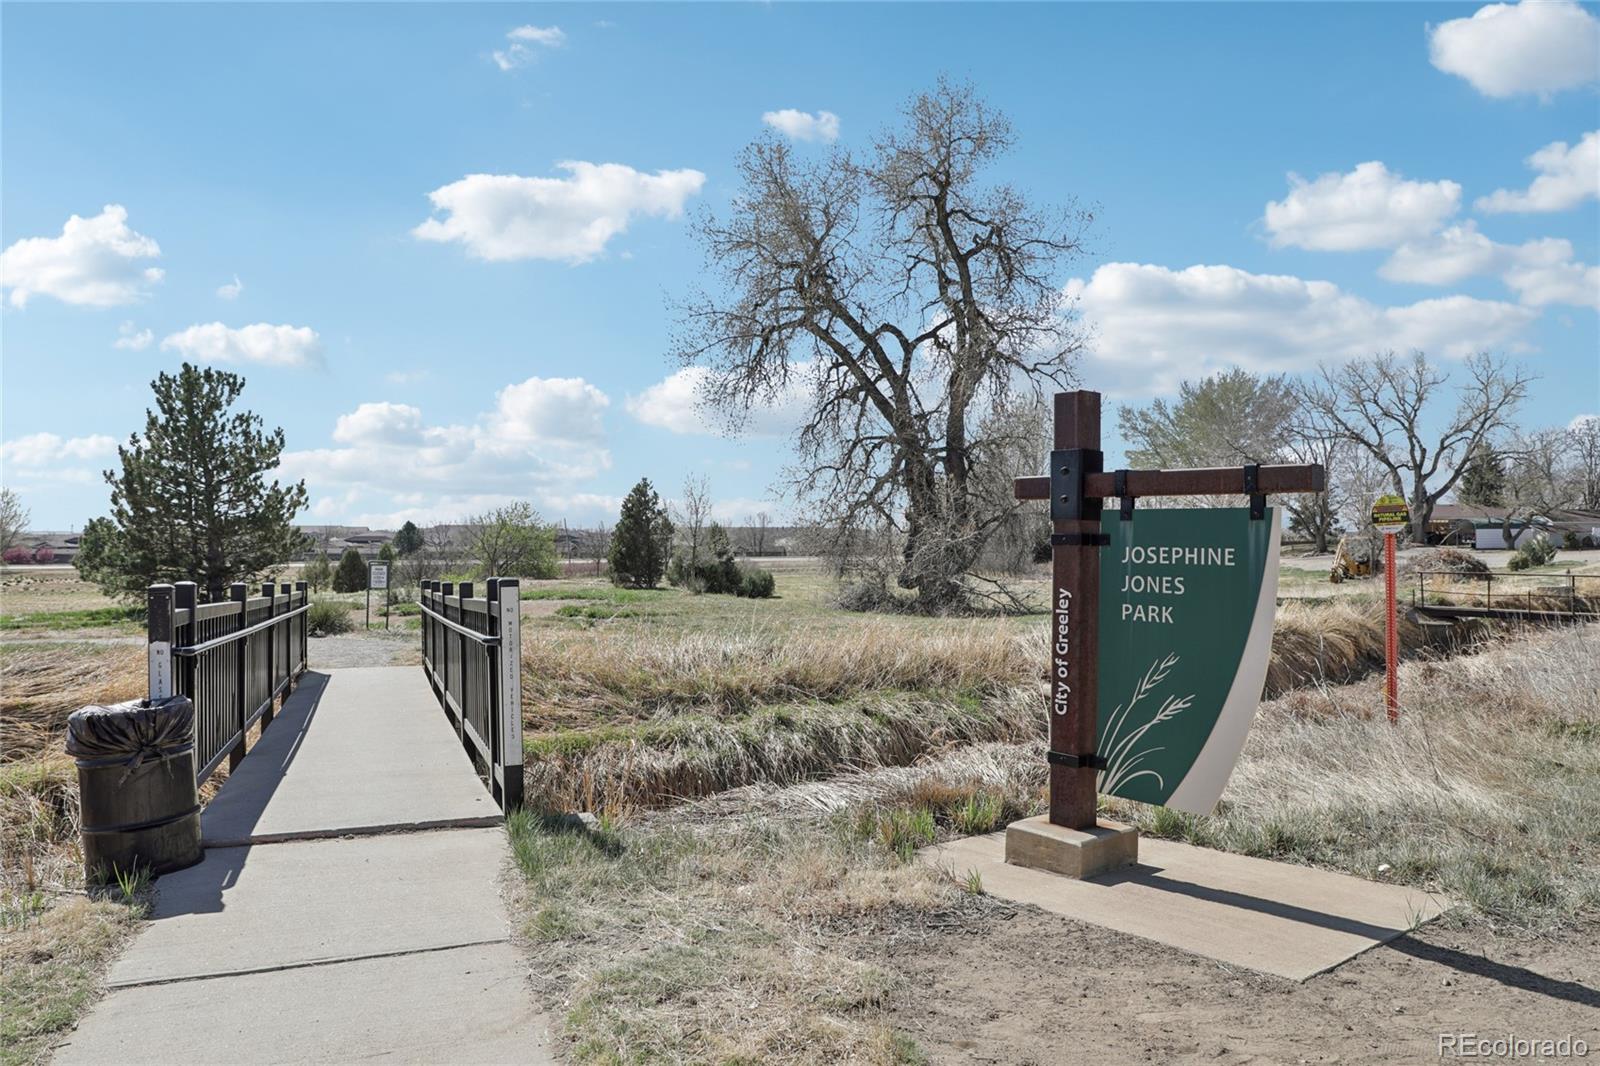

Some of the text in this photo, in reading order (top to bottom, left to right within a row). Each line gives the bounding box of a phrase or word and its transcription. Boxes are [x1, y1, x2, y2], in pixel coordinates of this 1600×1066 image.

[1121, 546, 1236, 566] JOSEPHINE
[1121, 575, 1185, 595] JONES
[1121, 604, 1174, 624] PARK
[1054, 588, 1073, 716] City of Greeley
